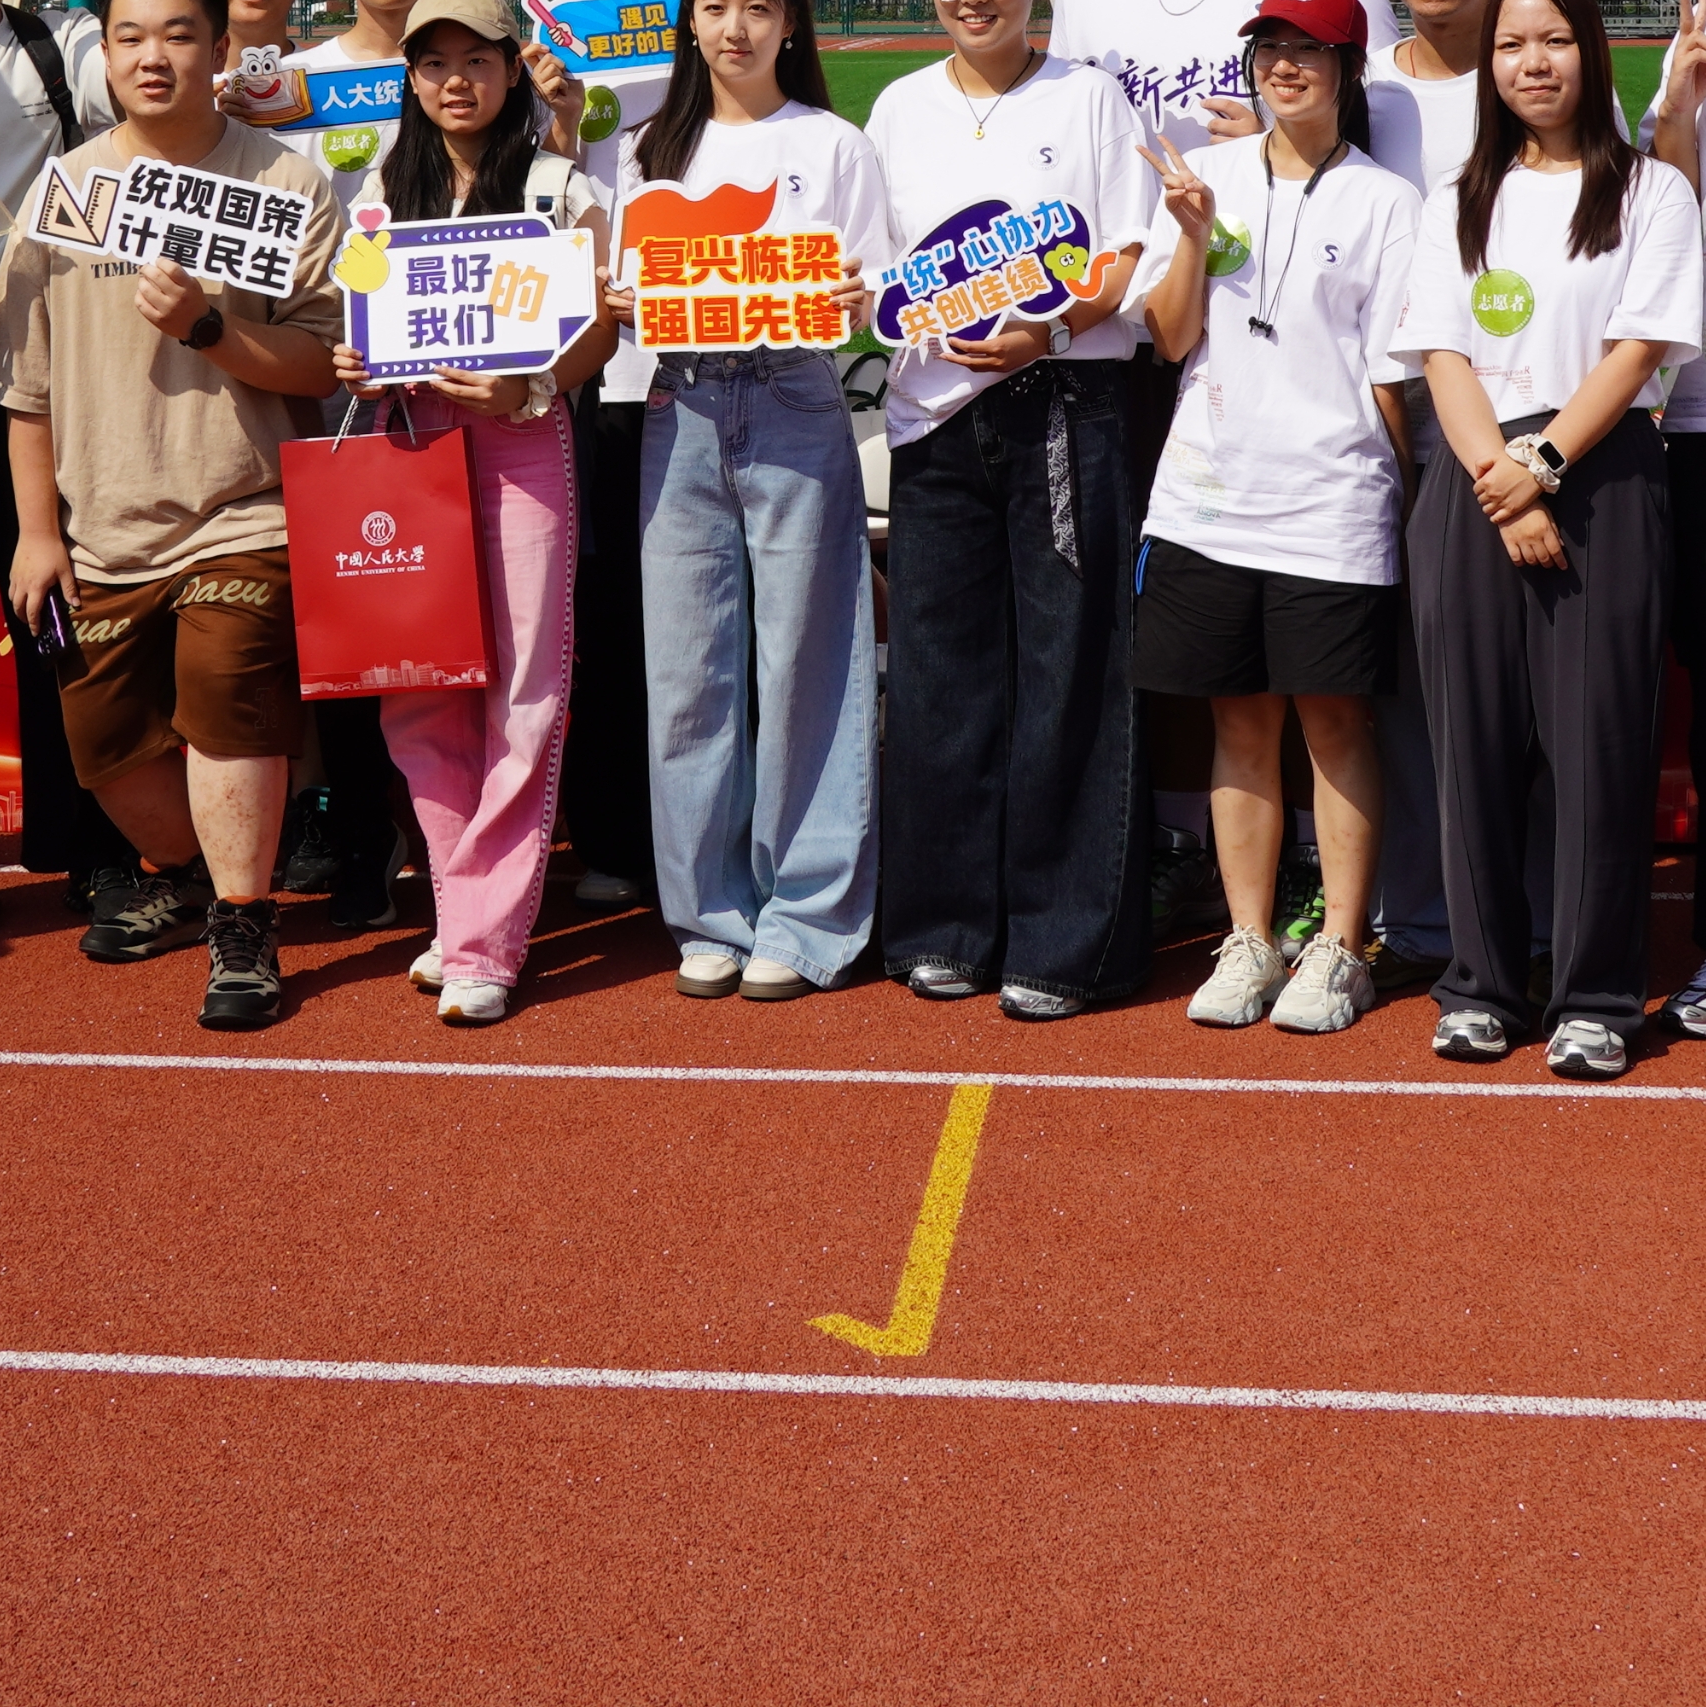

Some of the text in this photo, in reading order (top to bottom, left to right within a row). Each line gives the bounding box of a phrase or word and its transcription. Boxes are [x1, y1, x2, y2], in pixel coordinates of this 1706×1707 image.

[619, 4, 668, 30] 遇见
[321, 79, 405, 112] 人大统
[1087, 54, 1261, 129] 新共进
[329, 134, 372, 152] 志愿者
[126, 164, 306, 241] 统观国策
[117, 213, 291, 291] 计量民生
[638, 232, 844, 288] 复兴栋梁
[1206, 236, 1243, 257] 愿者
[407, 303, 495, 350] 我们
[640, 292, 845, 347] 强国先锋
[900, 256, 1049, 346] 共创佳绩
[1478, 293, 1526, 312] 志愿者
